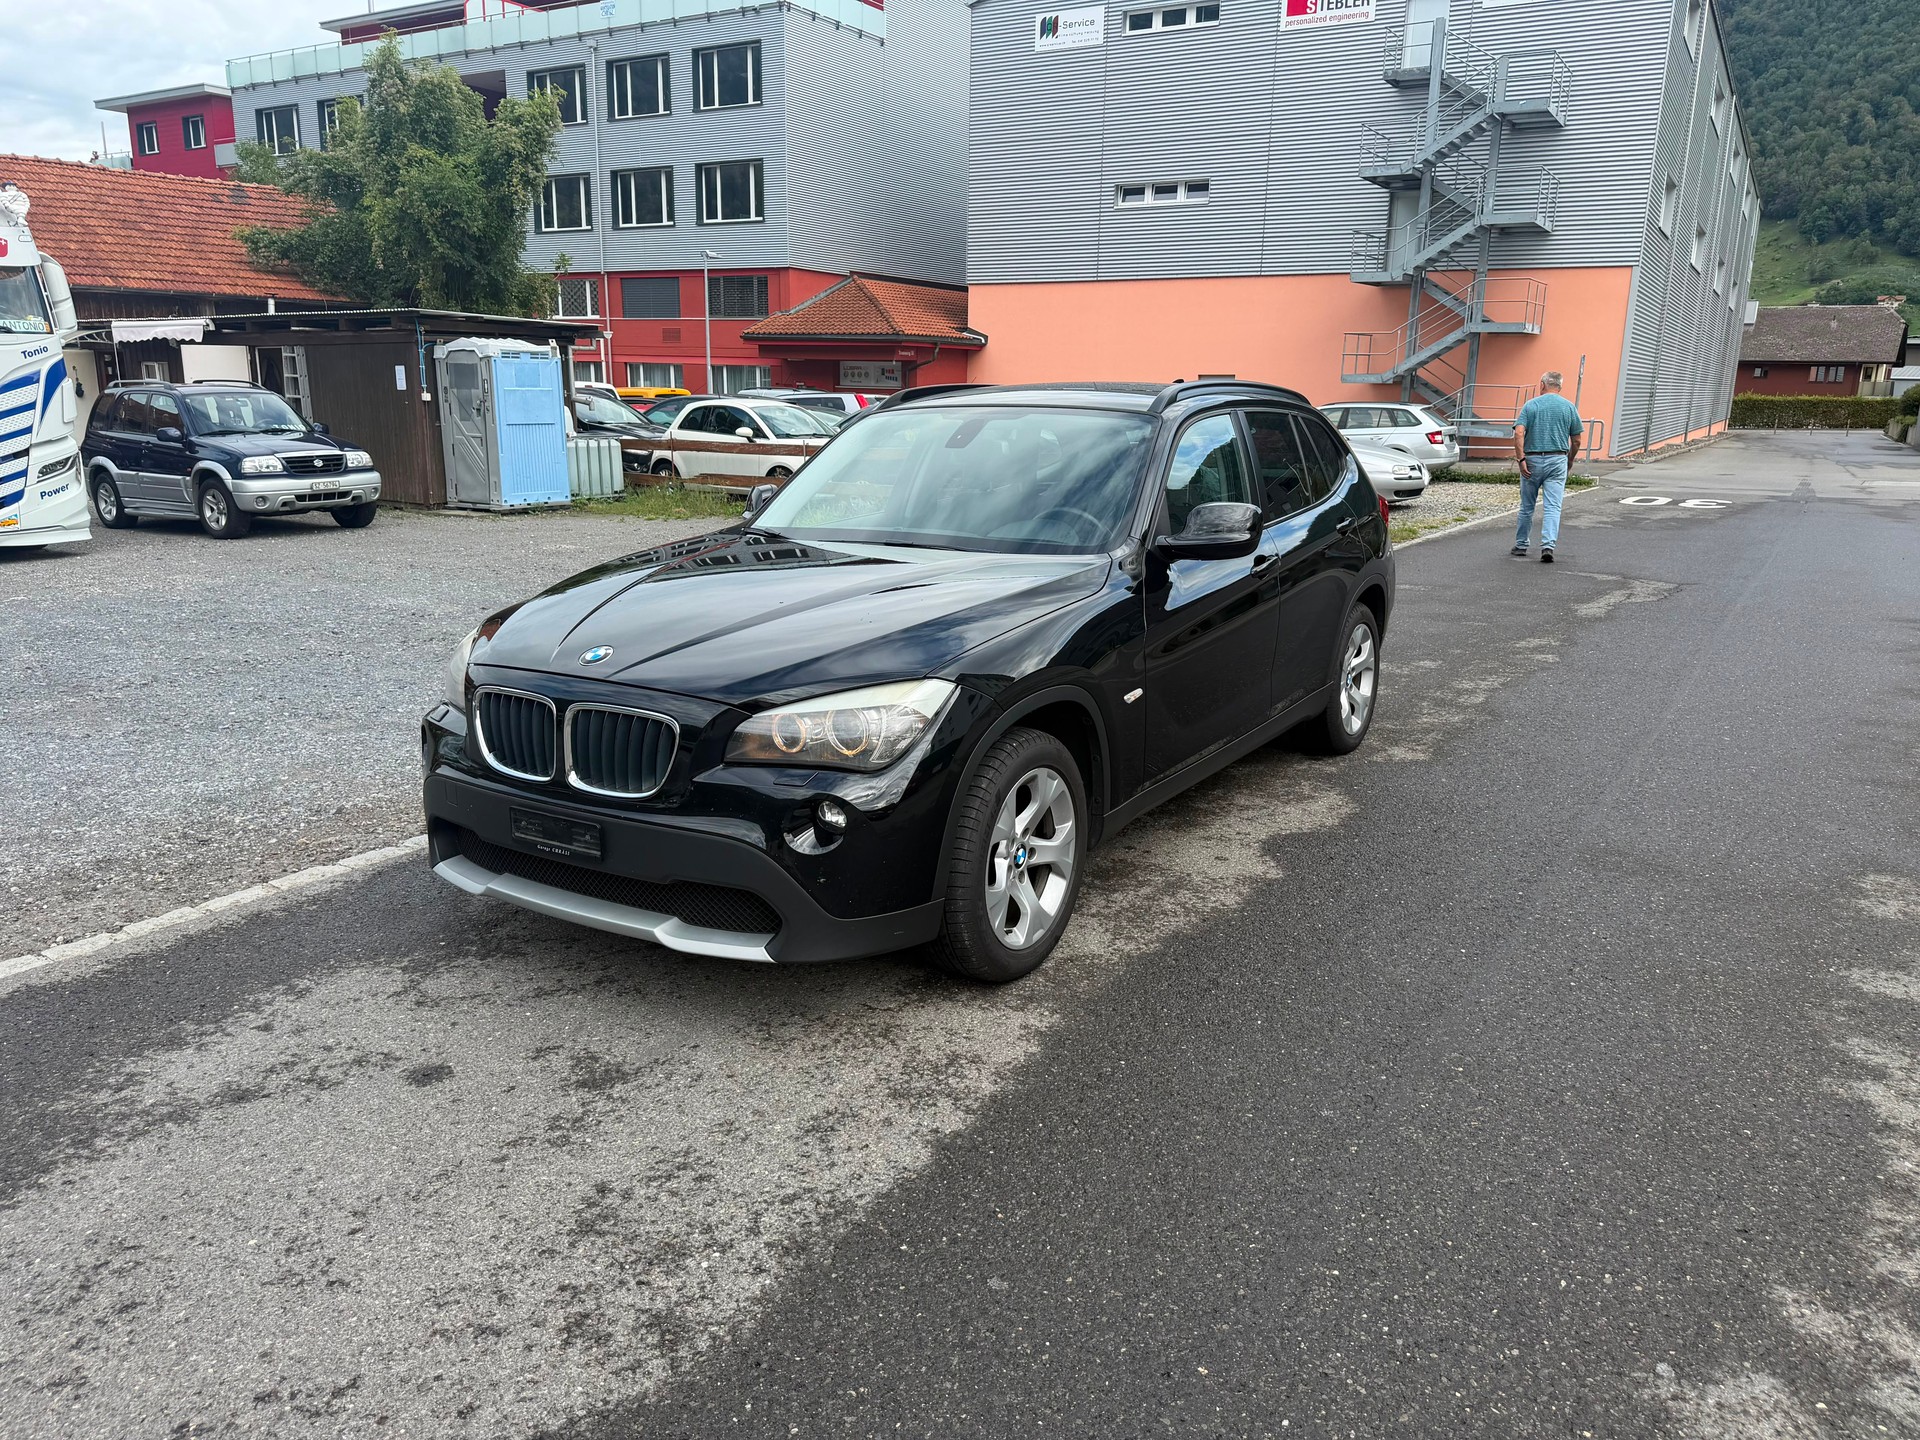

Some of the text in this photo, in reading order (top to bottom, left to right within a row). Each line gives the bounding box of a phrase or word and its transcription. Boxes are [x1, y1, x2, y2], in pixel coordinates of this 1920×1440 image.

[1285, 11, 1369, 28] personalized engineering
[21, 345, 49, 360] Tonio
[40, 483, 70, 500] Power
[1619, 496, 1732, 509] 30
